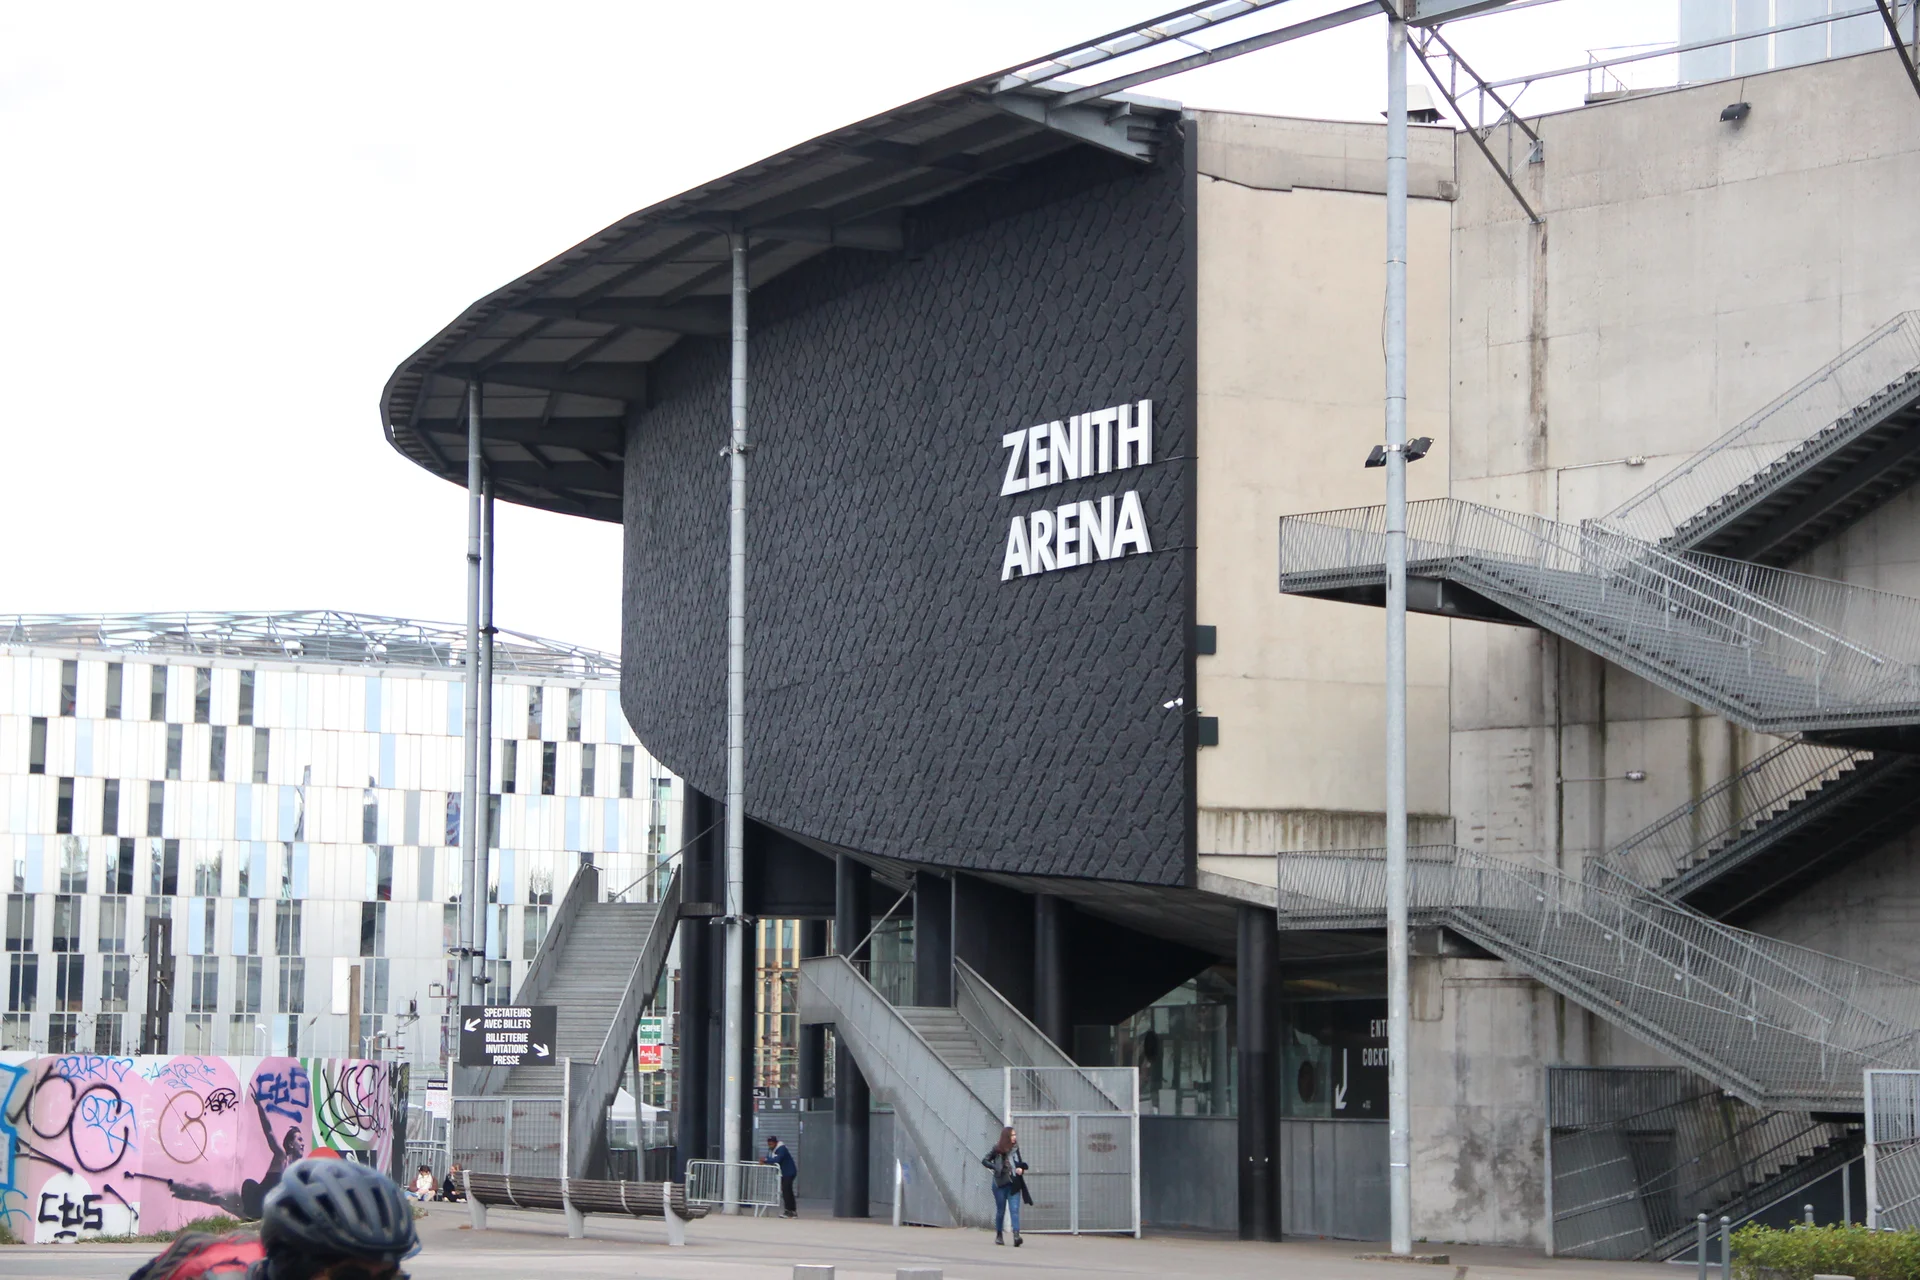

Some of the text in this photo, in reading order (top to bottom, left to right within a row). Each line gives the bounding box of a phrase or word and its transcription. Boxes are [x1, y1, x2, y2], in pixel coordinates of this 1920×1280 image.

[1000, 399, 1152, 497] ZENITH
[1000, 490, 1153, 581] ARENA
[484, 1008, 532, 1018] SPECTATEURS
[484, 1019, 532, 1029] AVEC BILLETS
[1370, 1019, 1388, 1038] ENT
[485, 1033, 528, 1042] BILLETTERIE
[485, 1044, 528, 1054] INVITATIONS
[493, 1055, 520, 1065] PRESSE
[1362, 1048, 1389, 1066] COCKT
